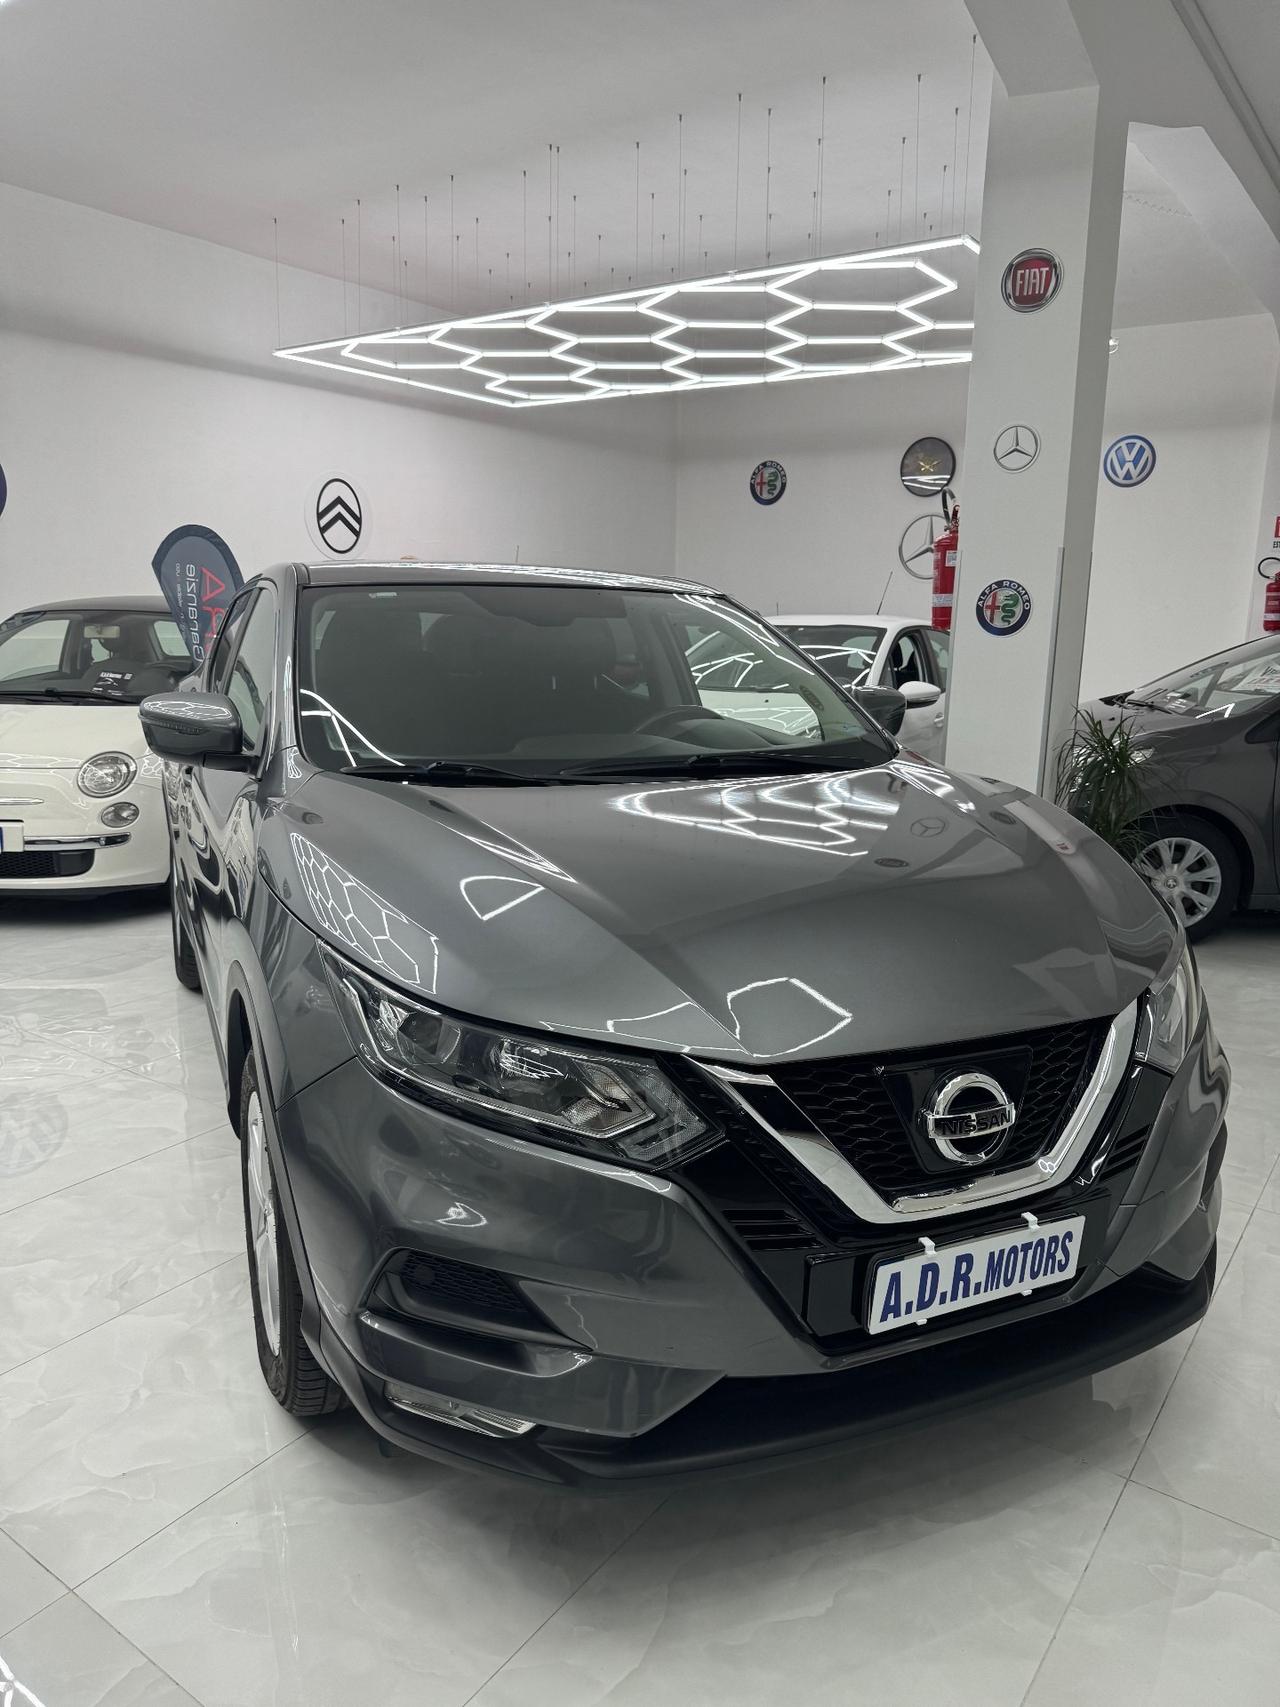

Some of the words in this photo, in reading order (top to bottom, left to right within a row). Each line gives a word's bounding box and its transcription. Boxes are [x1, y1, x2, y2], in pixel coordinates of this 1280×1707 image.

[1015, 267, 1049, 296] FIAT
[978, 584, 998, 607] ALFA
[1003, 581, 1030, 610] ROMEO
[942, 1110, 1011, 1136] NISSAN
